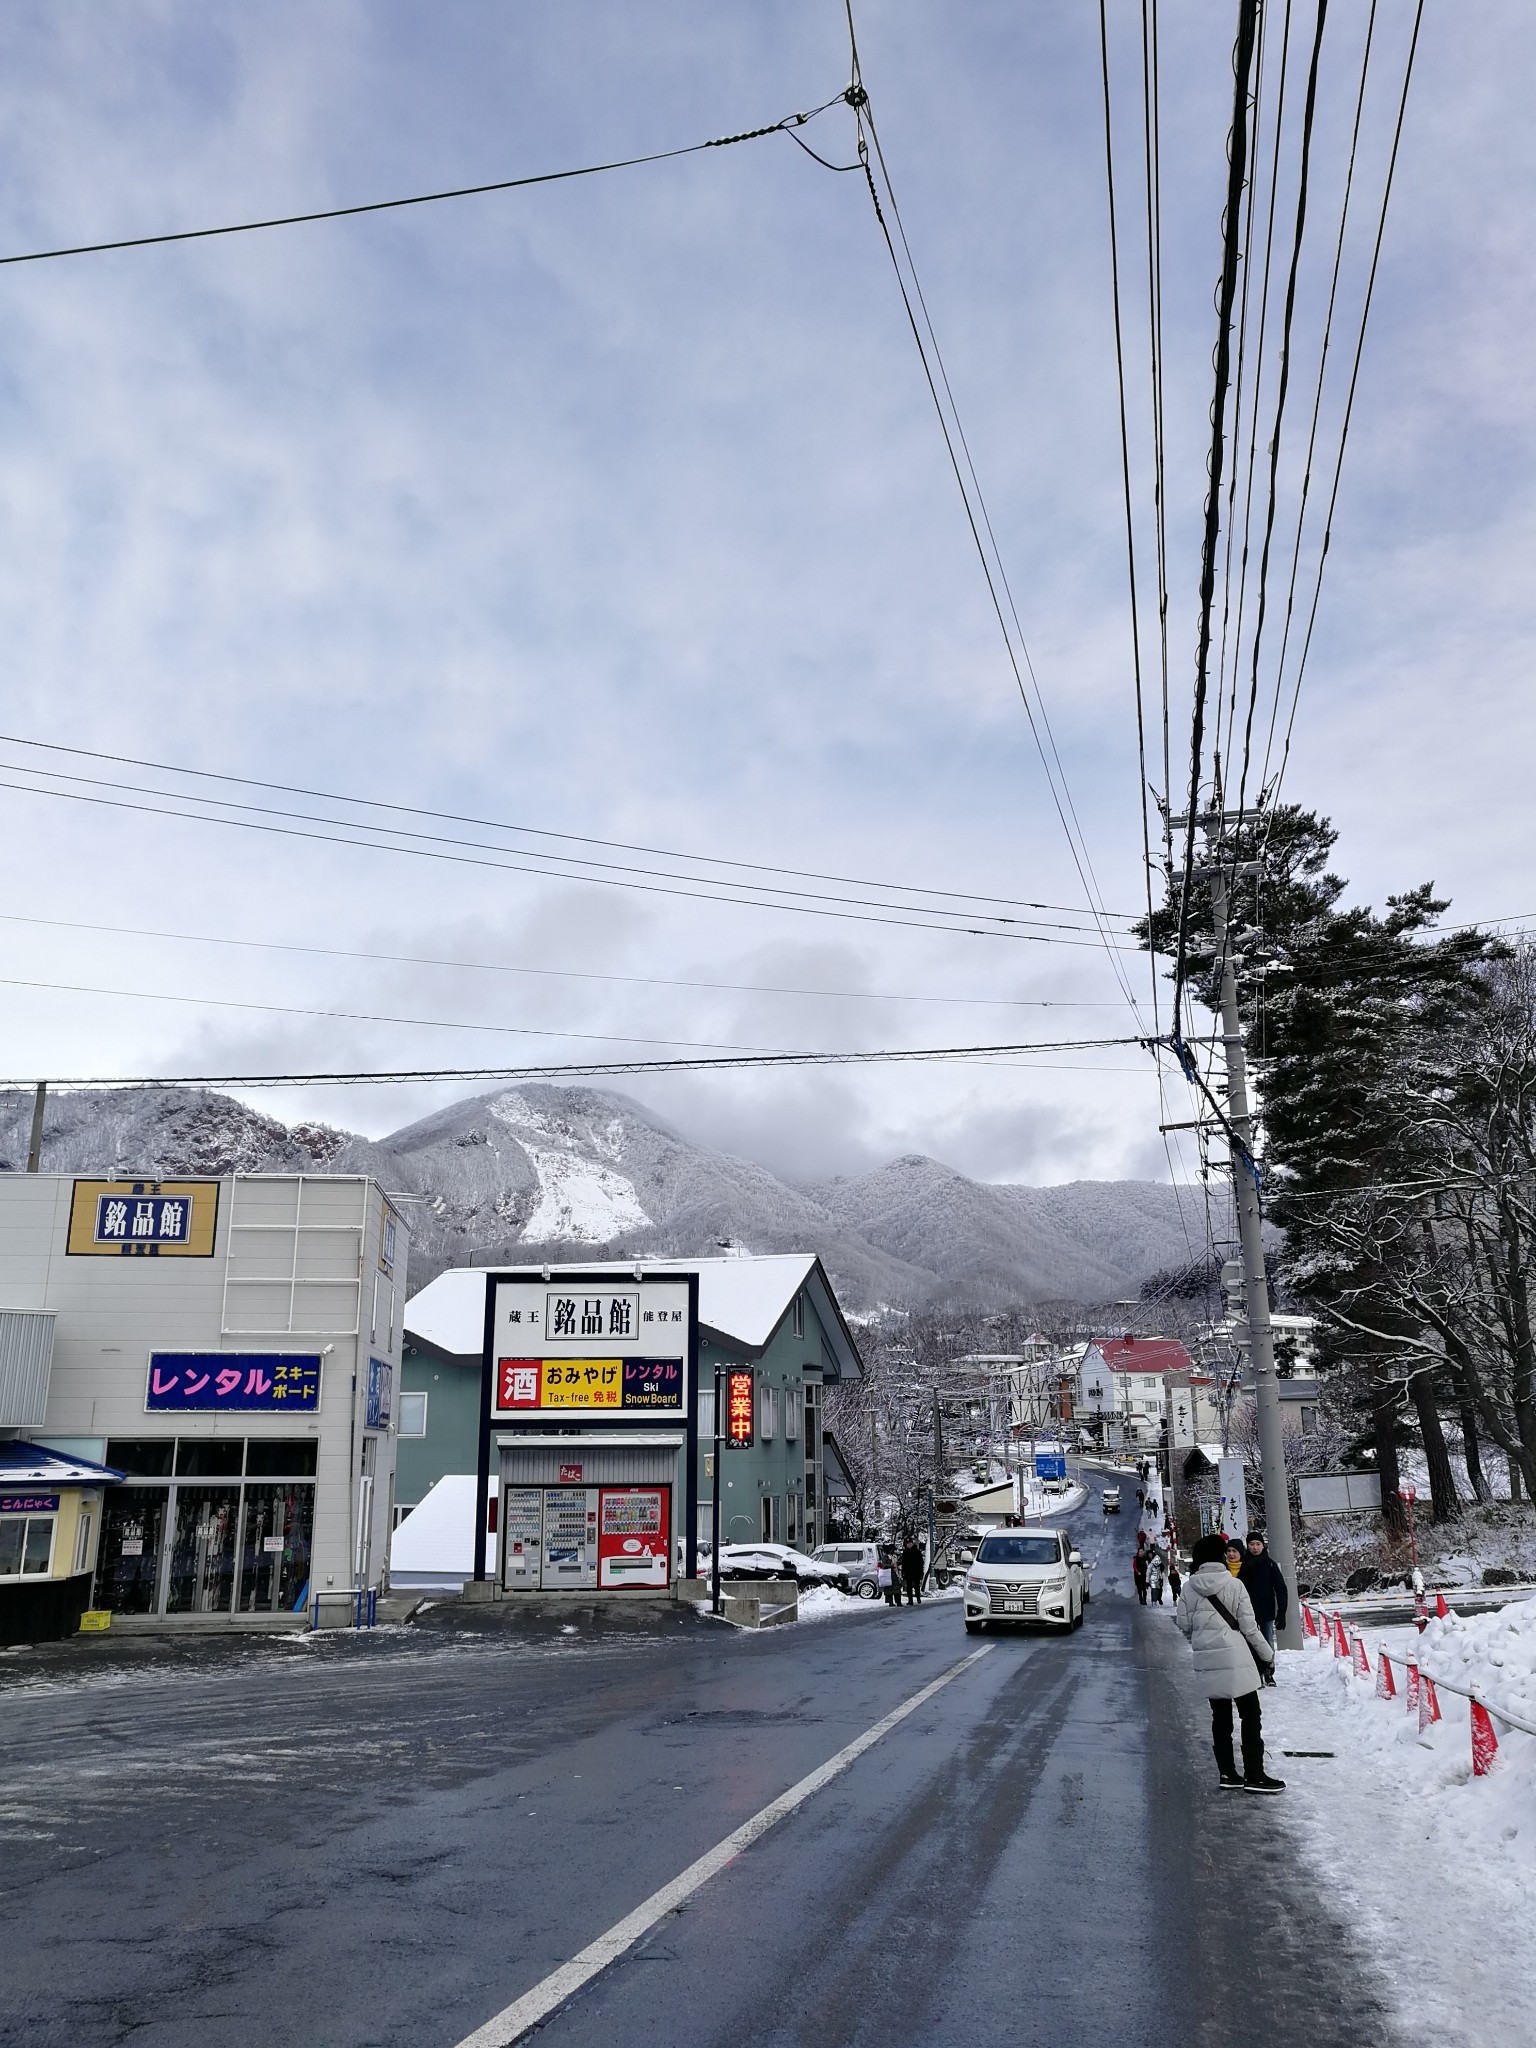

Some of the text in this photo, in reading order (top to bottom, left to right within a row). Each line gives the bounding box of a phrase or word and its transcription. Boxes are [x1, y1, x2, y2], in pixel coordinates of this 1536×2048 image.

[104, 1201, 184, 1237] 銘品館
[508, 1298, 683, 1335] 蔵王 銘品館 能登屋
[274, 1366, 317, 1380] スキー
[547, 1366, 618, 1385] おみやげ
[625, 1364, 678, 1380] レンタル
[152, 1368, 272, 1396] レンタル
[503, 1367, 539, 1401] 酒
[643, 1382, 659, 1392] Ski
[272, 1384, 315, 1399] ボード
[548, 1390, 618, 1403] Tax-free 免税
[731, 1375, 752, 1439] 営業中
[560, 1466, 581, 1481] たばこ
[2, 1498, 53, 1510] こんにゃく
